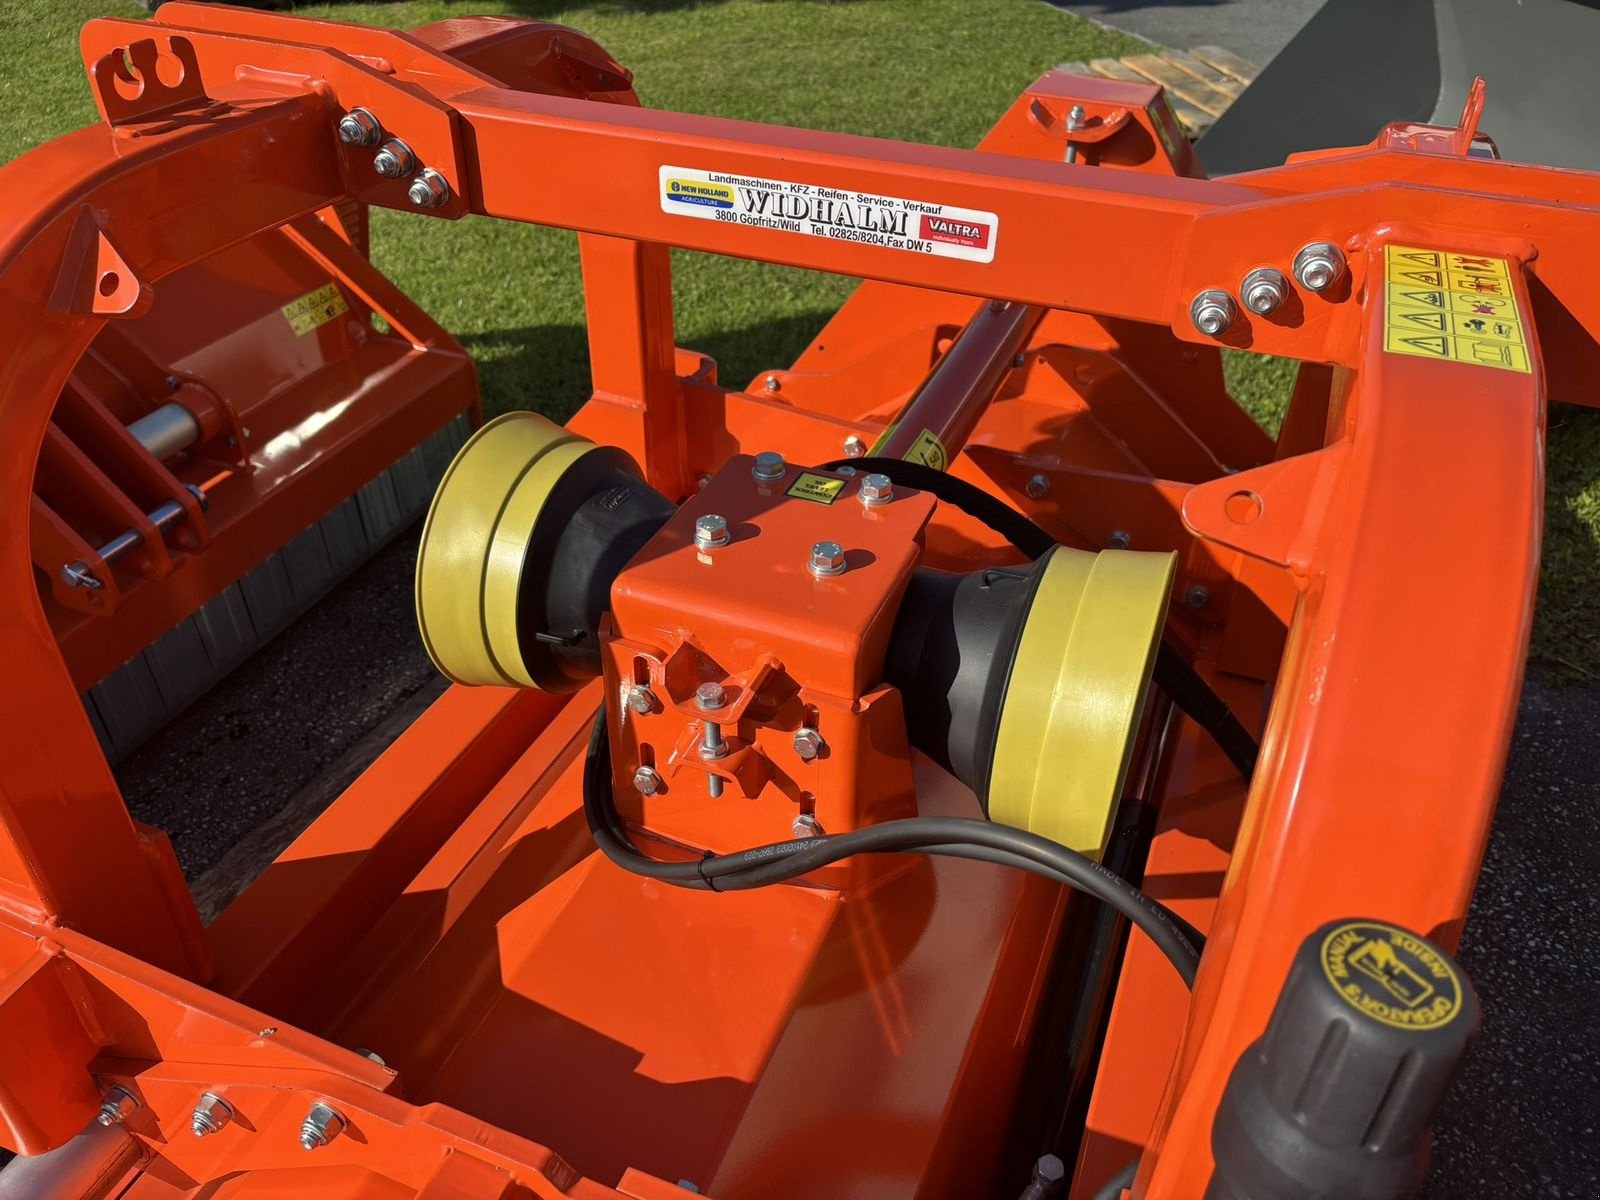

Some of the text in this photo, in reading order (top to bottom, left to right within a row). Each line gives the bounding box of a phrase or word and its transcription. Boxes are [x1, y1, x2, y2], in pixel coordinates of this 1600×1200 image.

[681, 186, 729, 198] NEW HOLLAND
[681, 195, 718, 206] AGRICULTURE
[708, 173, 782, 191] Landmaschinen
[790, 184, 810, 196] KFZ
[818, 187, 848, 201] Reifen
[856, 194, 894, 208] Service
[902, 200, 943, 215] Verkauf
[738, 187, 908, 236] WIDHALM
[715, 209, 738, 222] 3800
[739, 213, 801, 232] Göpfritz/Wild
[810, 223, 827, 236] Tel.
[906, 239, 924, 251] DW
[925, 242, 933, 253] 5
[929, 217, 981, 238] VALTRA
[795, 487, 832, 498] CONTROL
[1090, 862, 1121, 885] MADE
[1329, 930, 1366, 978] MANUAL
[1389, 931, 1449, 978] INSIDE
[1343, 983, 1452, 1024] OPERATOR'S
